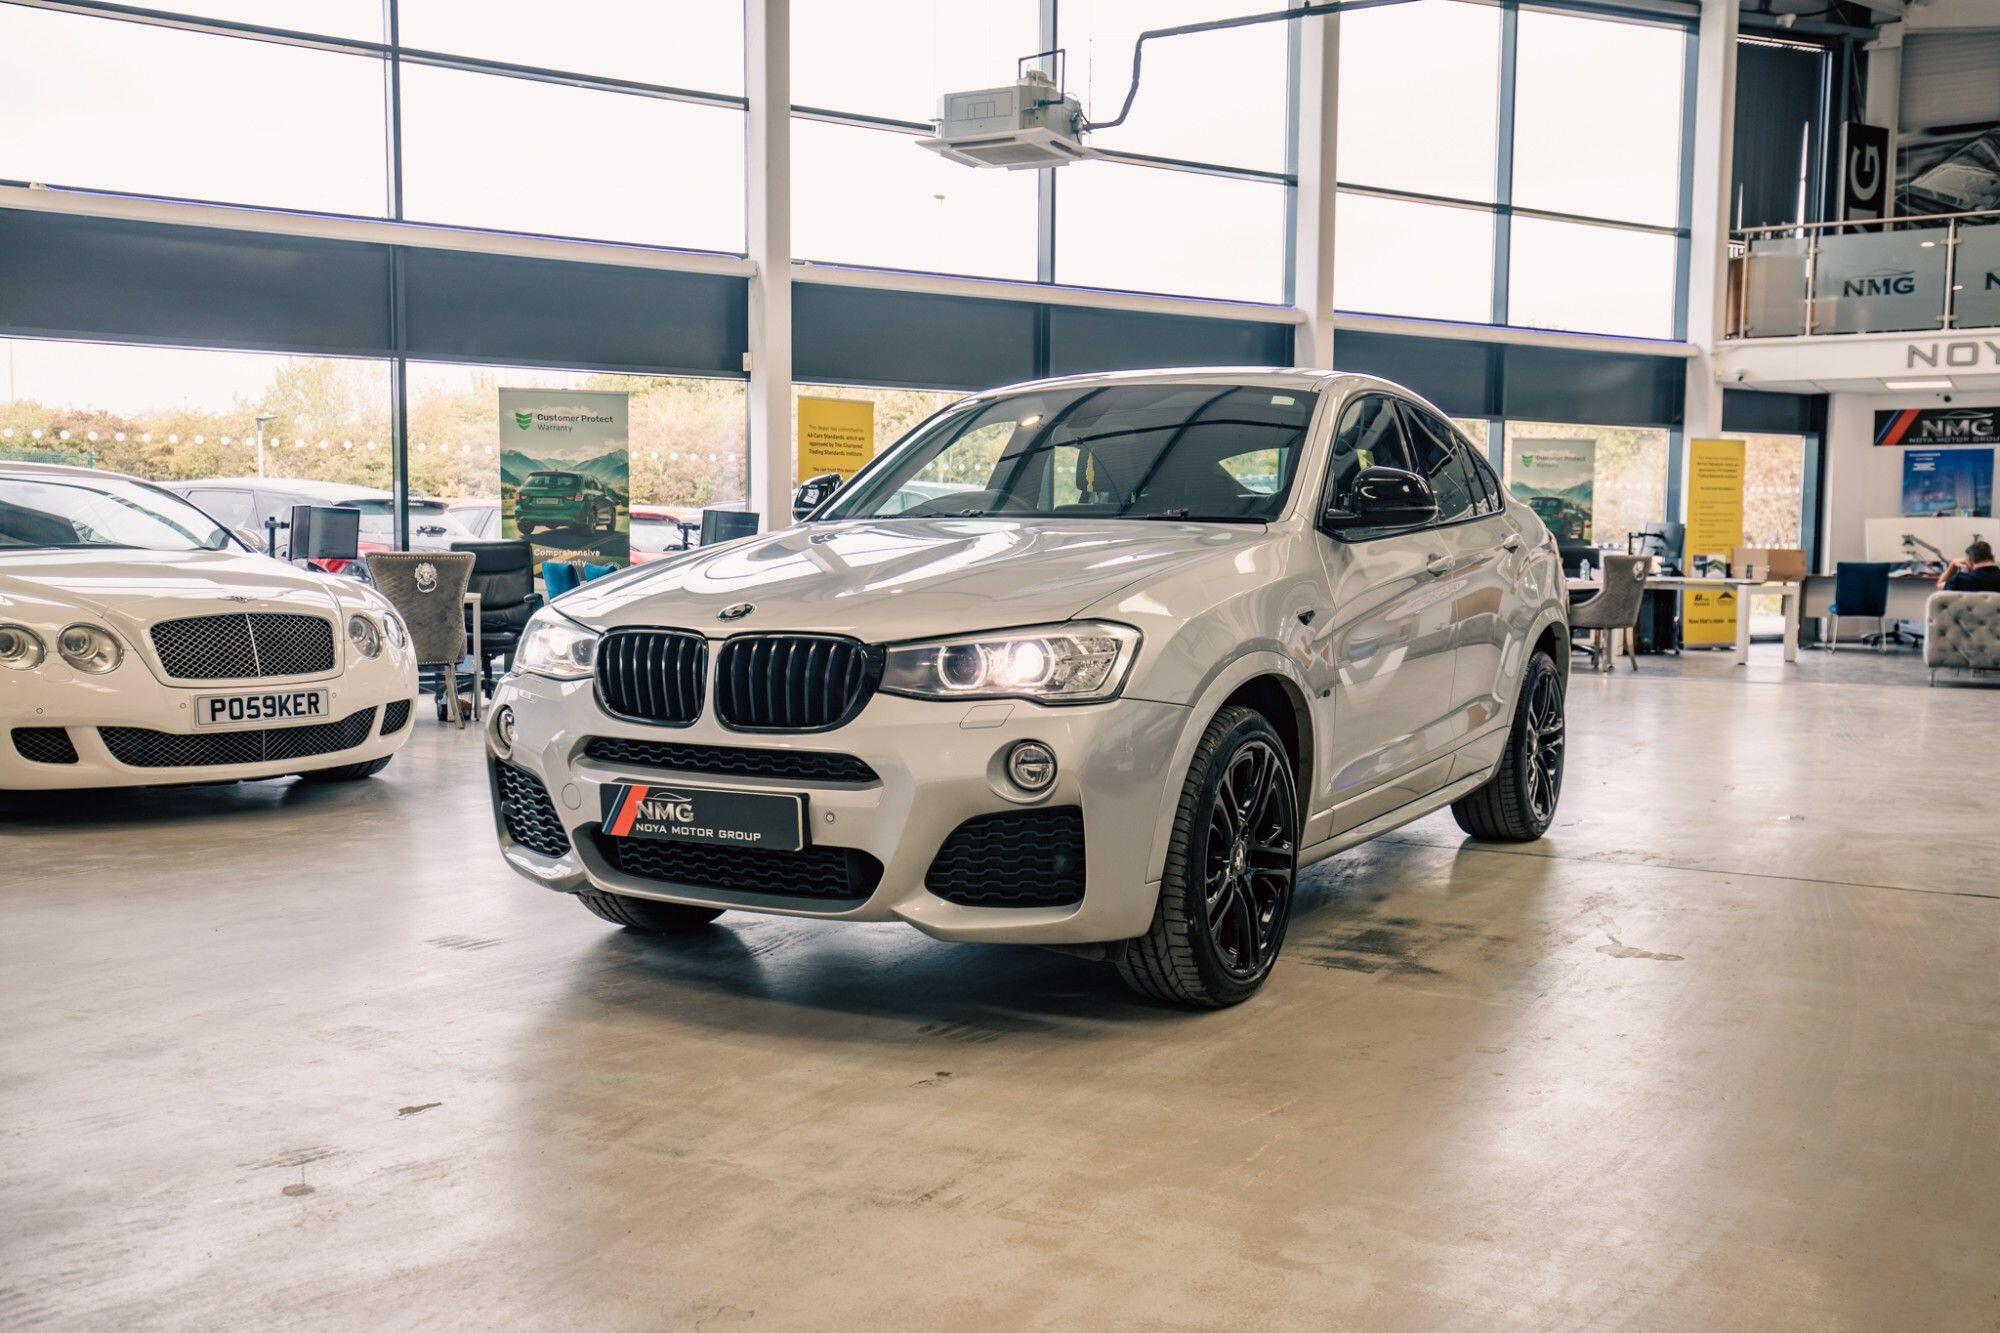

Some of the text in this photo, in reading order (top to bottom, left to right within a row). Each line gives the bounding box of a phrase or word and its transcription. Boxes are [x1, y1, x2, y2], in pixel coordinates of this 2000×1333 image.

[1843, 277, 1915, 297] NMG
[537, 413, 613, 423] Customer Protect
[537, 424, 573, 432] Warranty
[1921, 419, 1994, 437] NMG
[533, 549, 600, 558] Comprehensive
[636, 800, 694, 822] NMG
[636, 823, 761, 842] NOYA MOTOR GROUP
